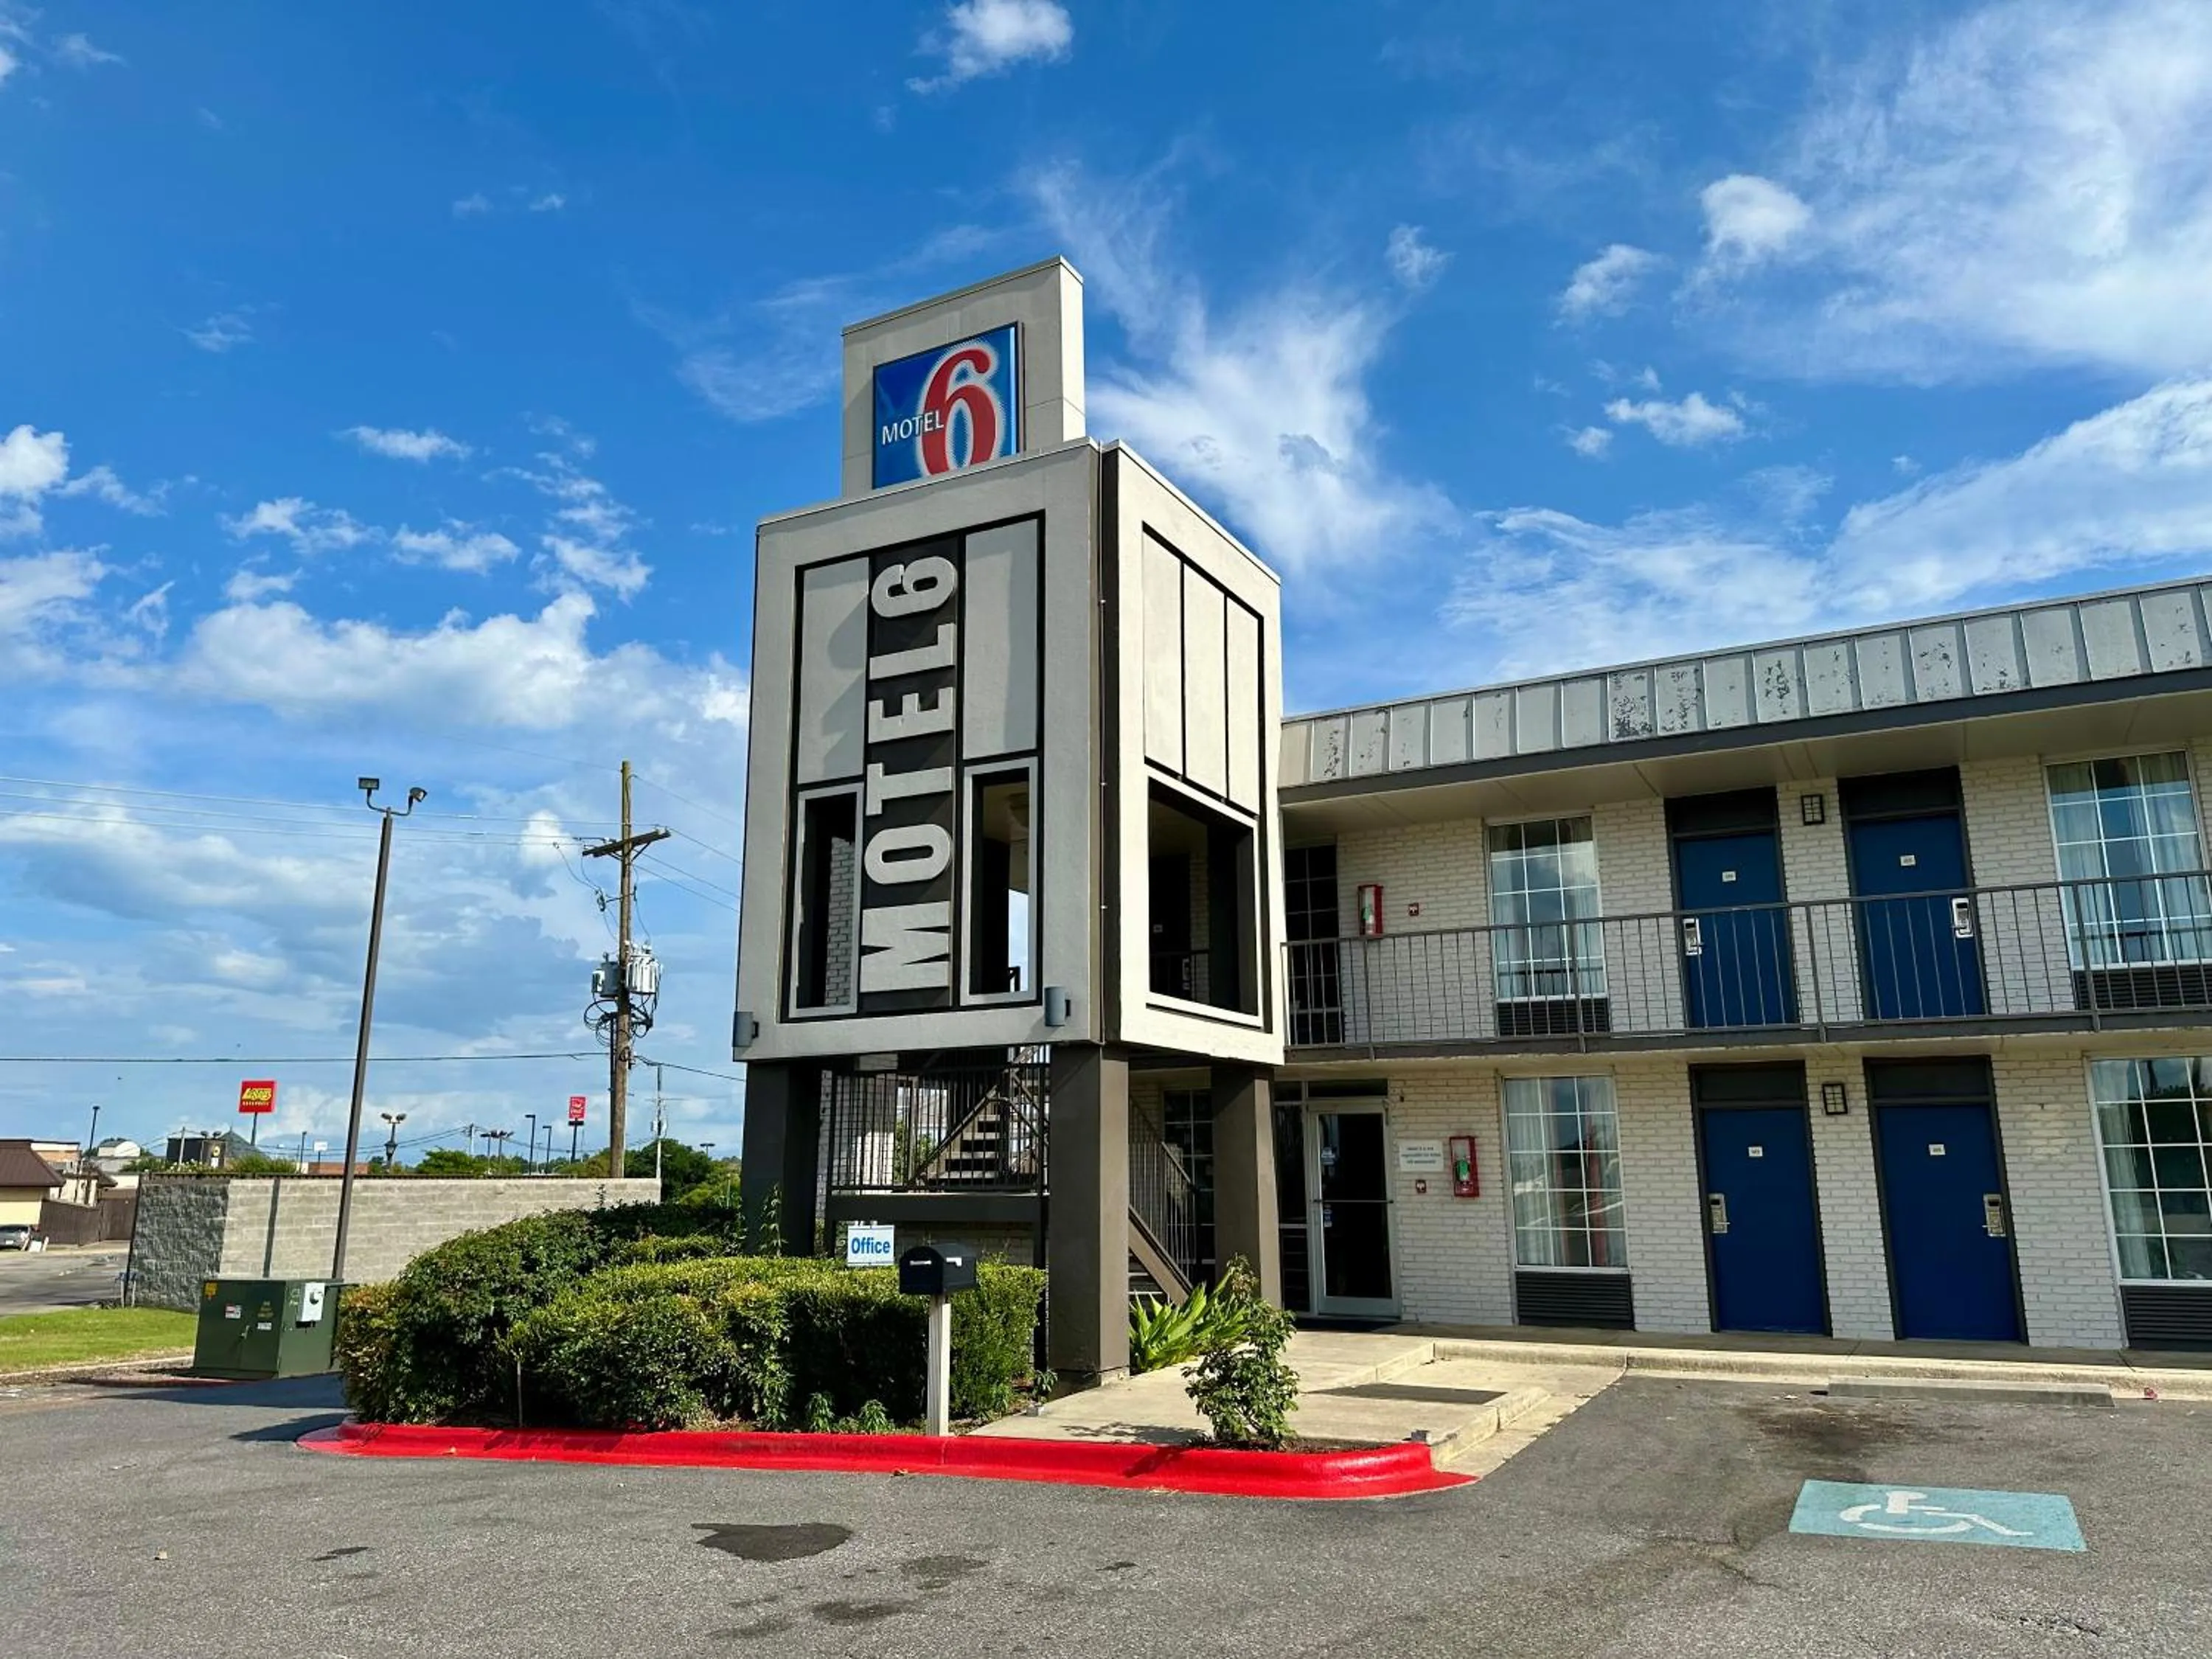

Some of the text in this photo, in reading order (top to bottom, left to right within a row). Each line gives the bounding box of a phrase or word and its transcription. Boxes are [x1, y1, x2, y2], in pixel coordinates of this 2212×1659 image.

[882, 348, 996, 476] MOTEL 6
[860, 556, 957, 993] MOTEL 6
[851, 1237, 891, 1254] Office
